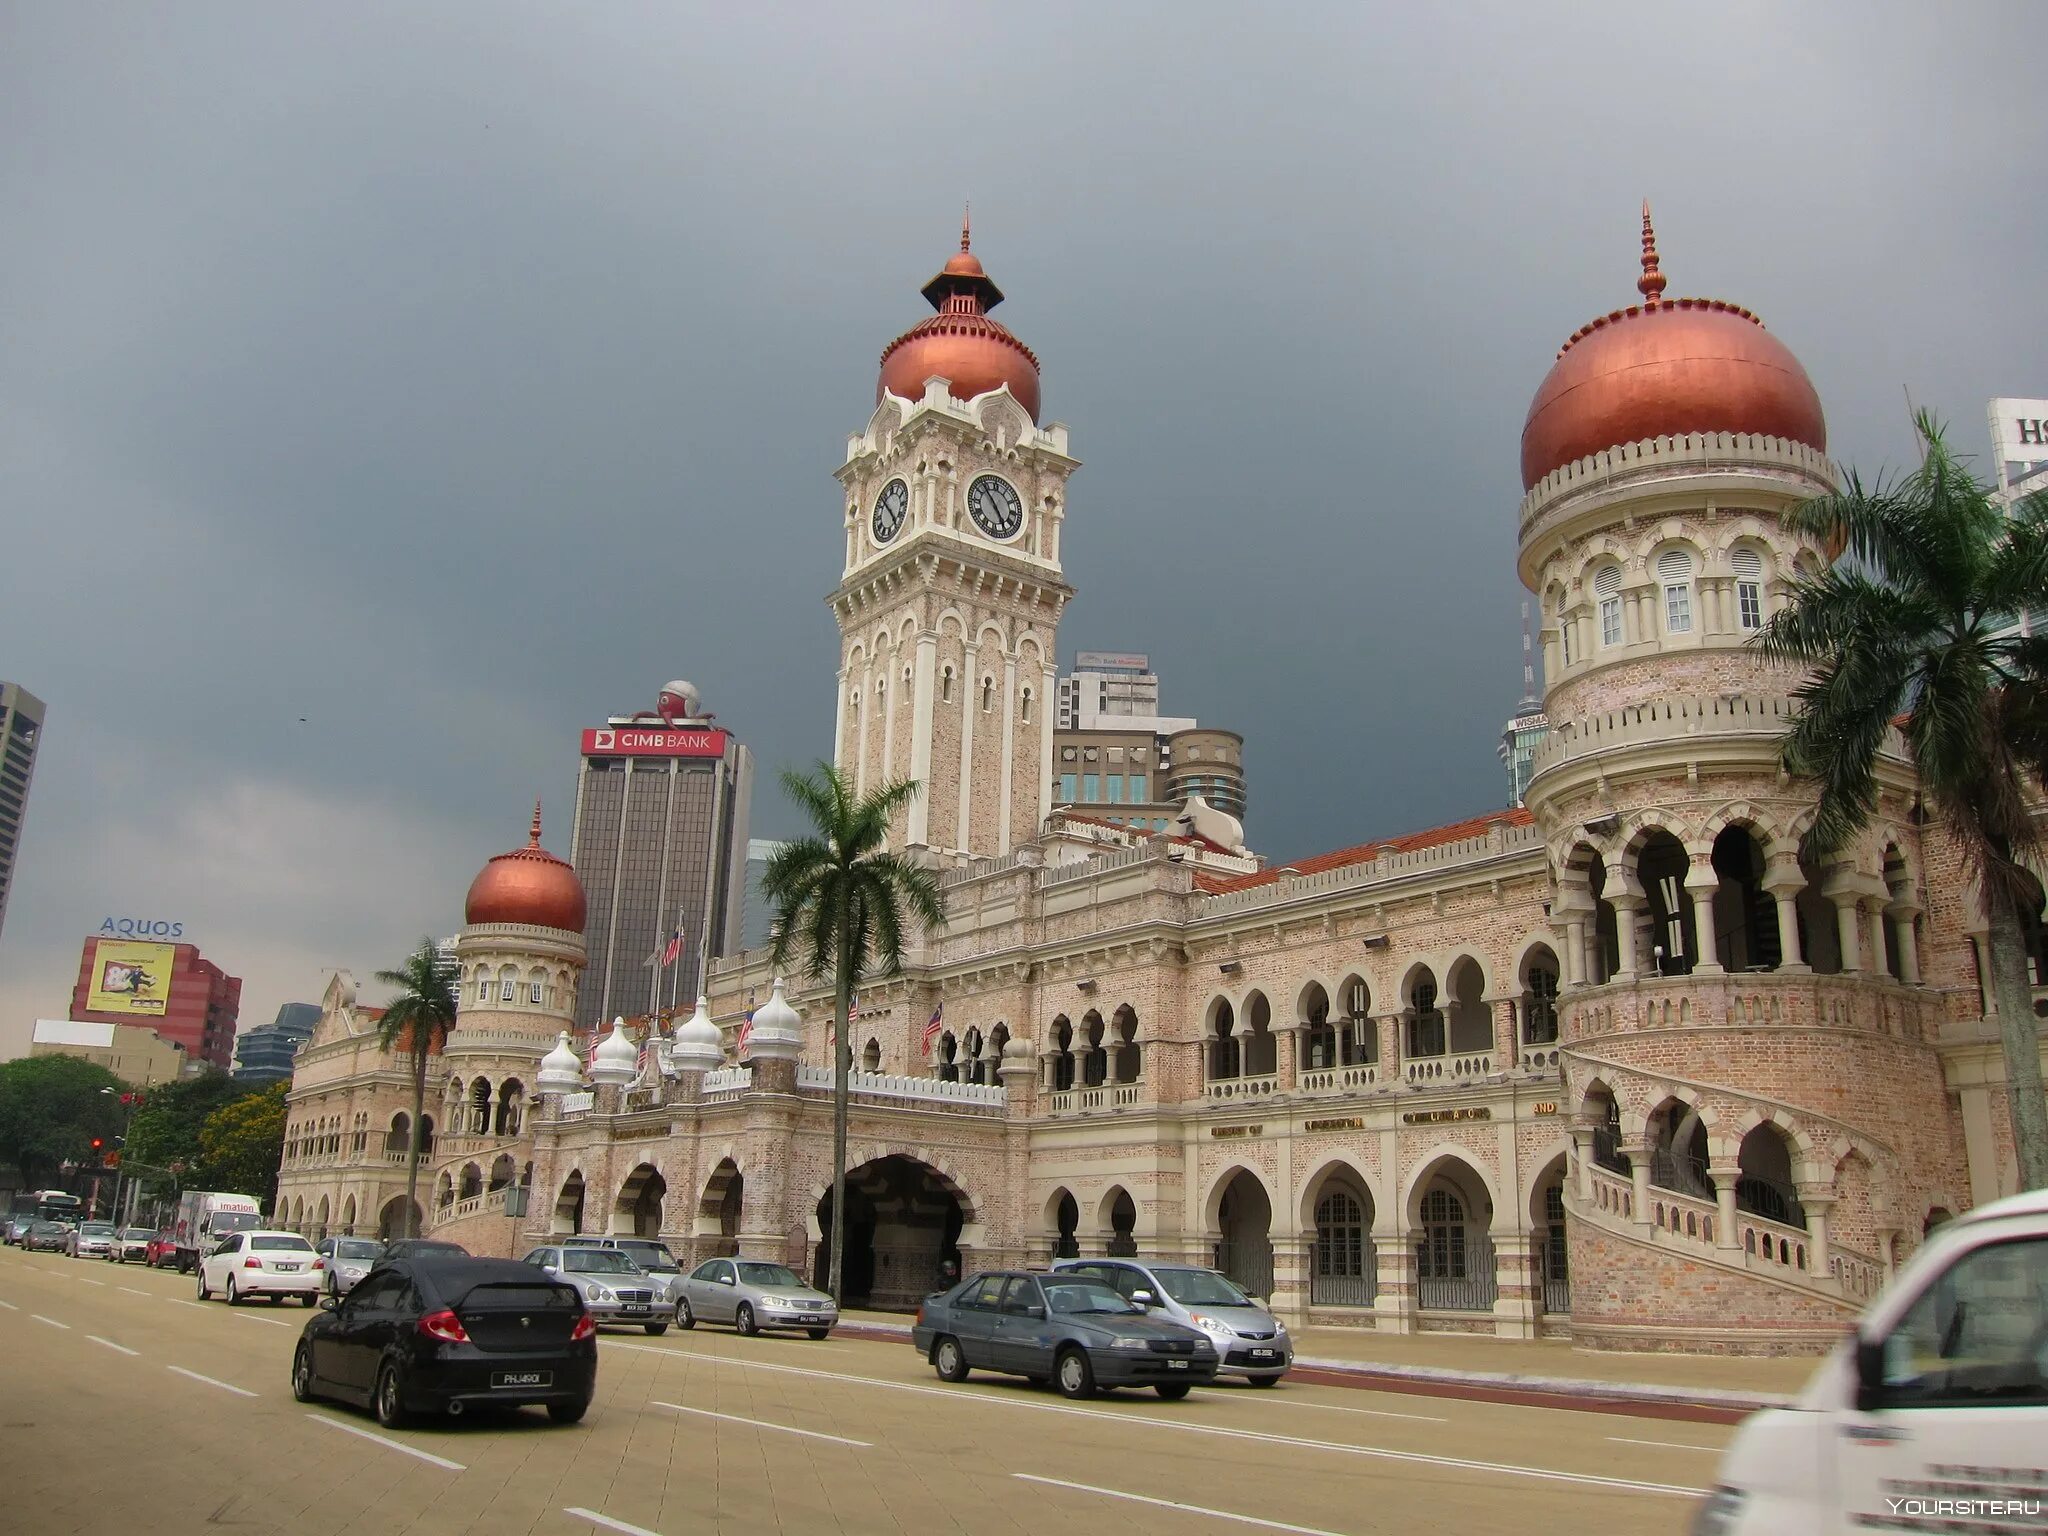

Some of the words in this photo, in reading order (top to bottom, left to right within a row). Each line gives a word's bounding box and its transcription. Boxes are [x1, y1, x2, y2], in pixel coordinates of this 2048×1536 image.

[621, 733, 664, 747] CIMB
[667, 735, 710, 749] BANK
[100, 917, 183, 938] AQUOS
[1532, 1103, 1555, 1114] AND
[220, 1202, 254, 1213] imation
